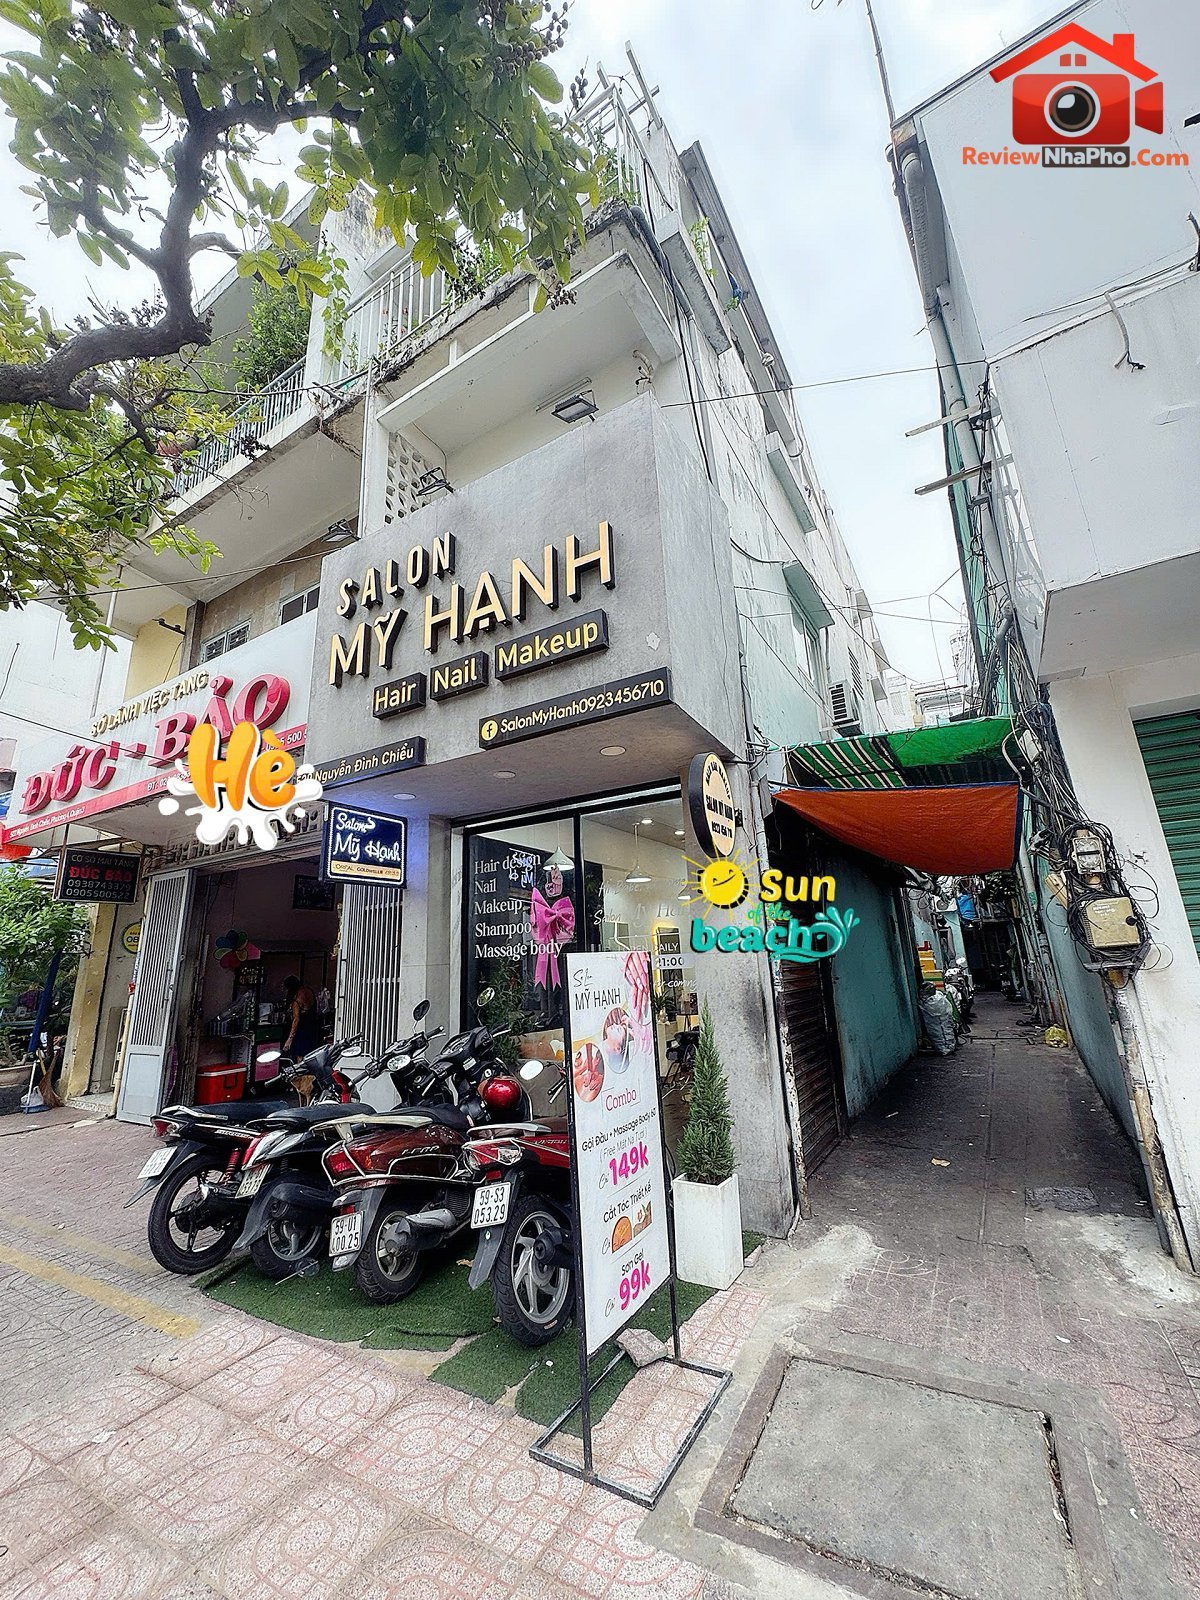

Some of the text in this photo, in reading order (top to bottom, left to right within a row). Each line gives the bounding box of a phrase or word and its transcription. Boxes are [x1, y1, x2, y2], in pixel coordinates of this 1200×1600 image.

[336, 532, 455, 619] SALON
[329, 520, 613, 687] MỸ HẠNH
[375, 620, 598, 712] Hair Nail Makeup
[501, 678, 664, 734] SalonMyHanh0923456710
[315, 760, 351, 783] Nguyễn
[354, 756, 378, 773] Đình
[381, 743, 414, 765] Chiểu
[19, 740, 120, 815] ĐỨC
[336, 812, 375, 833] Salon
[333, 832, 401, 862] Mỹ Hạnh
[474, 854, 541, 874] Hair design
[474, 878, 497, 895] Nail
[474, 898, 522, 915] Makeup
[475, 922, 531, 939] Shampoo
[475, 939, 563, 962] Massage body
[575, 988, 620, 1011] MỸ HẠNH
[605, 1088, 637, 1111] Combo
[613, 1118, 638, 1138] Massage
[609, 1141, 649, 1185] 149k
[480, 1187, 505, 1205] 59-S3
[603, 1180, 652, 1223] Cắt Tóc Thiết Kế
[335, 1216, 357, 1235] 59-U1
[474, 1204, 505, 1225] 053.29
[634, 1248, 644, 1264] Gel
[619, 1260, 651, 1311] 99k
